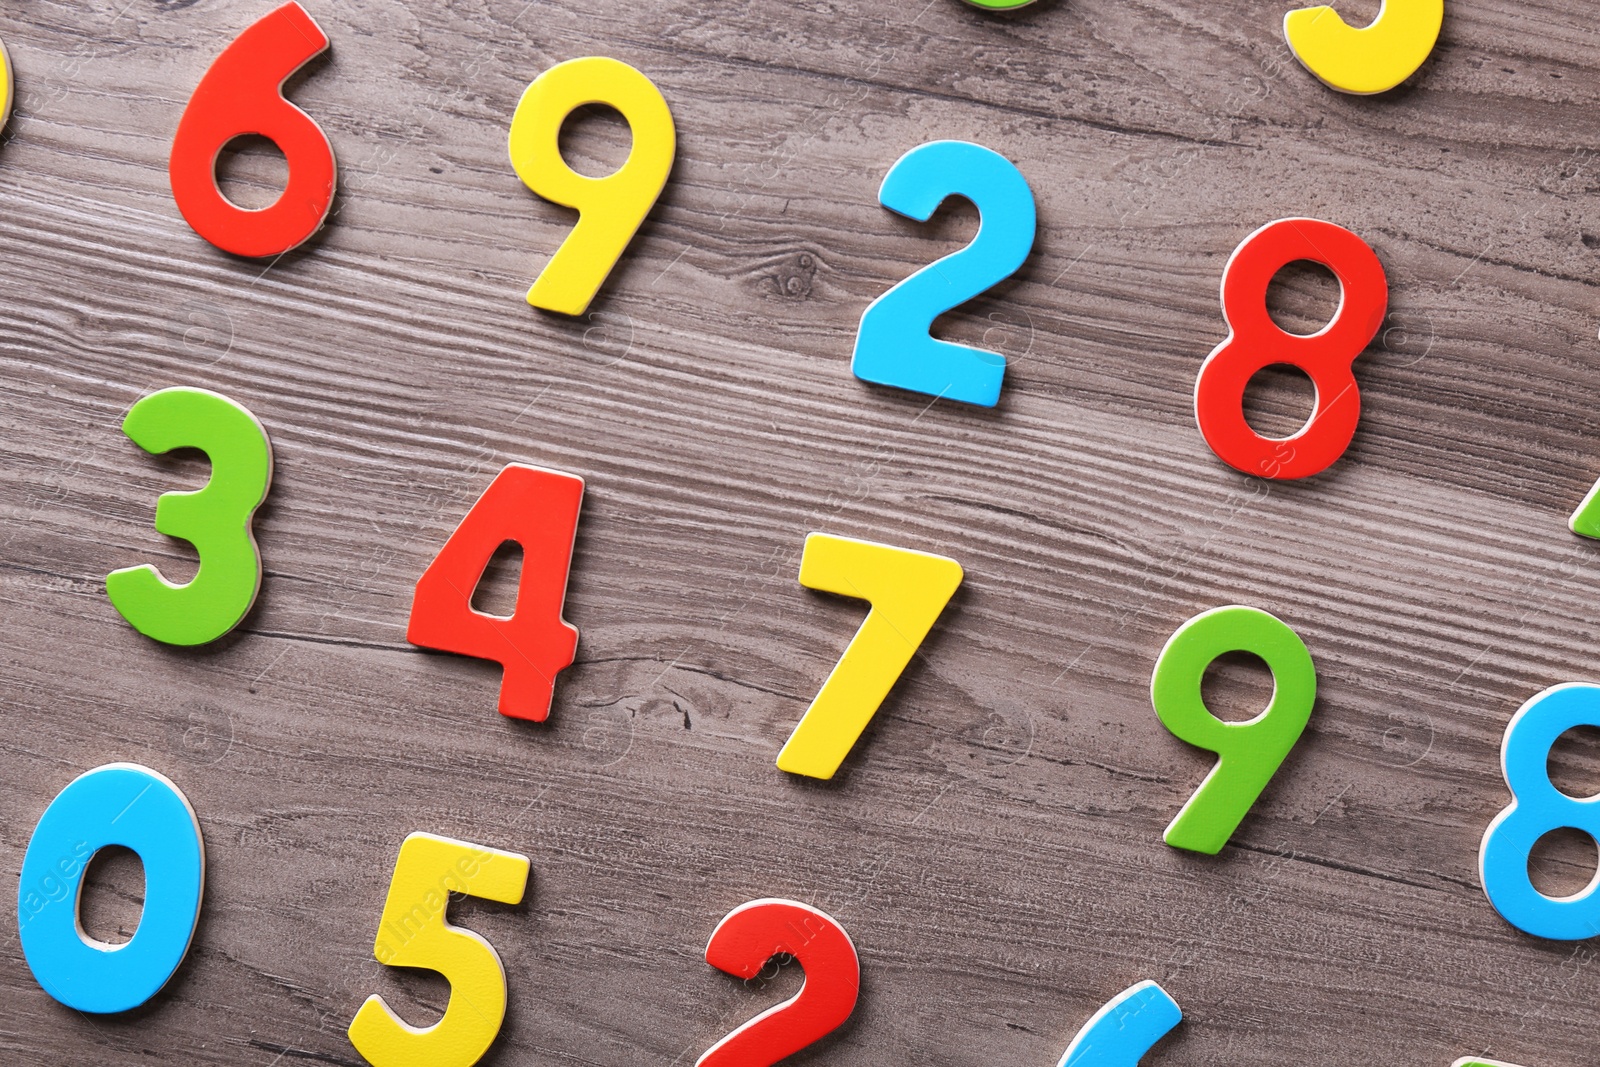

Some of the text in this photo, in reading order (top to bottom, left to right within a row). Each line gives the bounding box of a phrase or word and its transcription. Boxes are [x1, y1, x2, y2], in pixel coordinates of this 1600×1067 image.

[168, 1, 337, 258] 6
[508, 56, 676, 316] 9
[851, 139, 1037, 408] 2
[1194, 216, 1389, 481] 8
[105, 386, 274, 647] 3
[406, 462, 586, 723] 4
[776, 531, 964, 781] 7
[1151, 605, 1317, 855] 9
[18, 762, 206, 1015] 0
[347, 831, 531, 1067] 5
